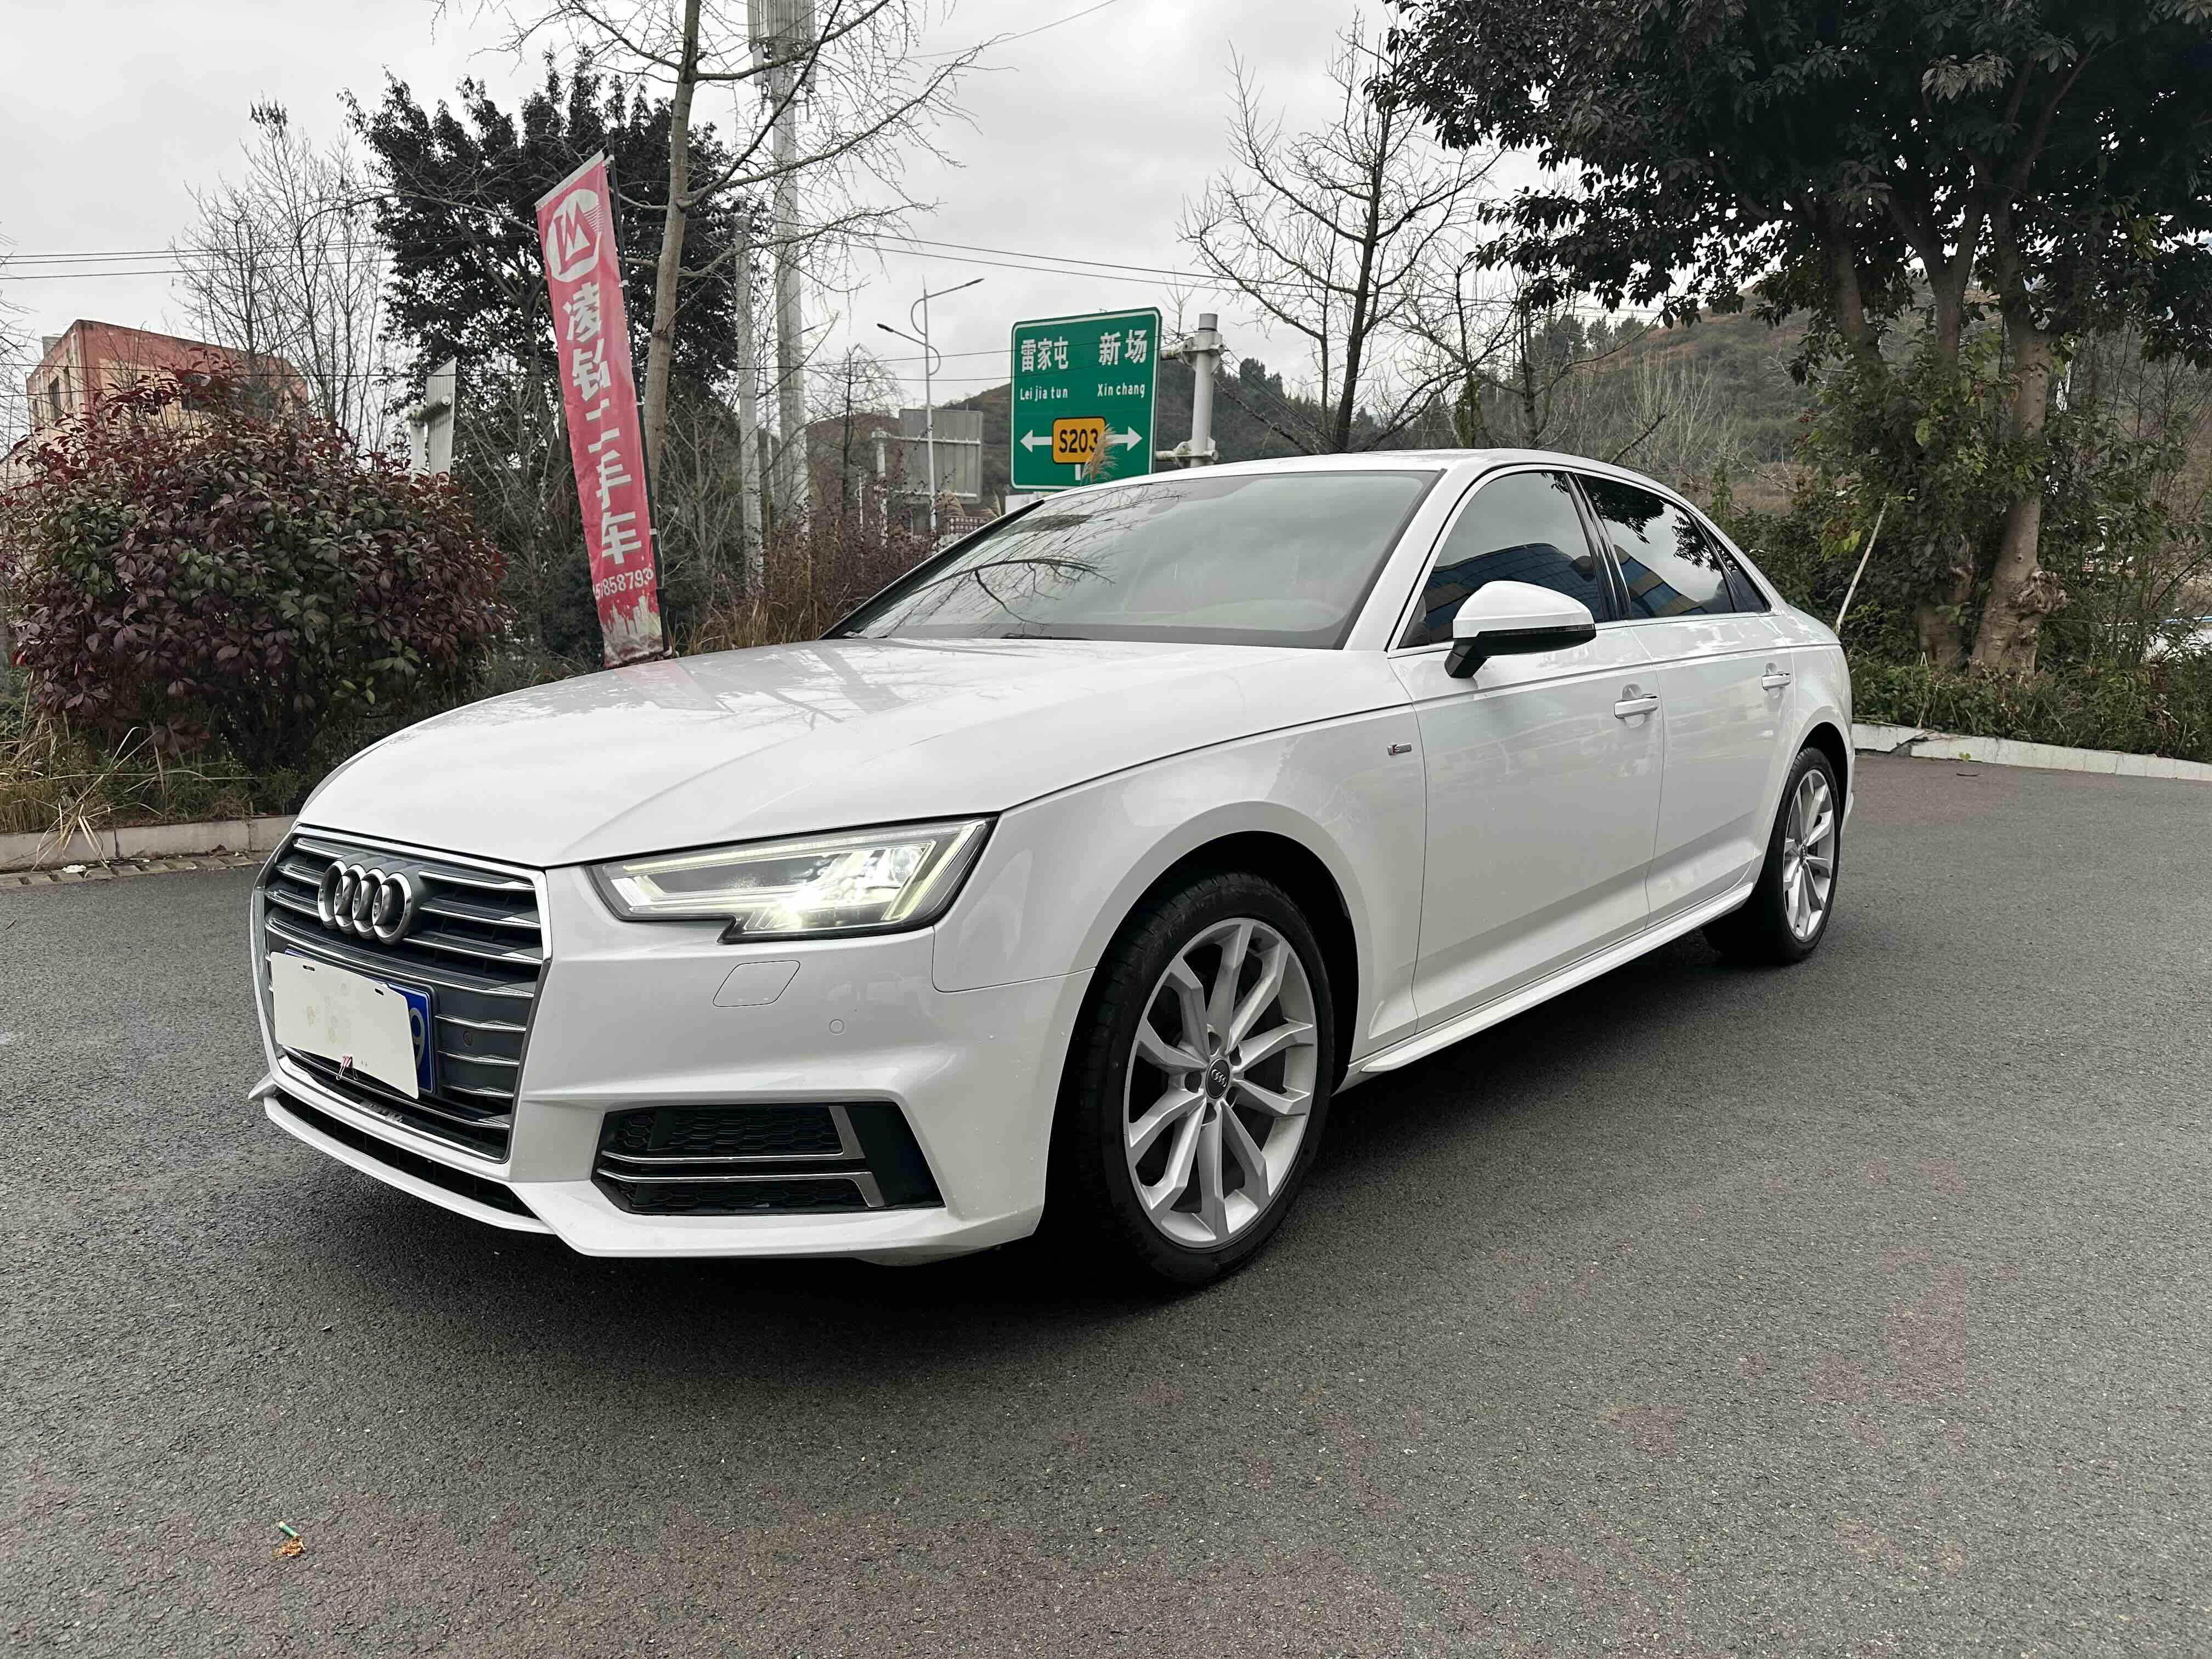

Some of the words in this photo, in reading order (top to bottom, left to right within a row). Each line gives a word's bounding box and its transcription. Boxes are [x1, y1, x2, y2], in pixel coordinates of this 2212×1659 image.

[1020, 336, 1069, 372] 雷家屯
[1098, 329, 1148, 365] 新场
[1058, 428, 1098, 453] S203
